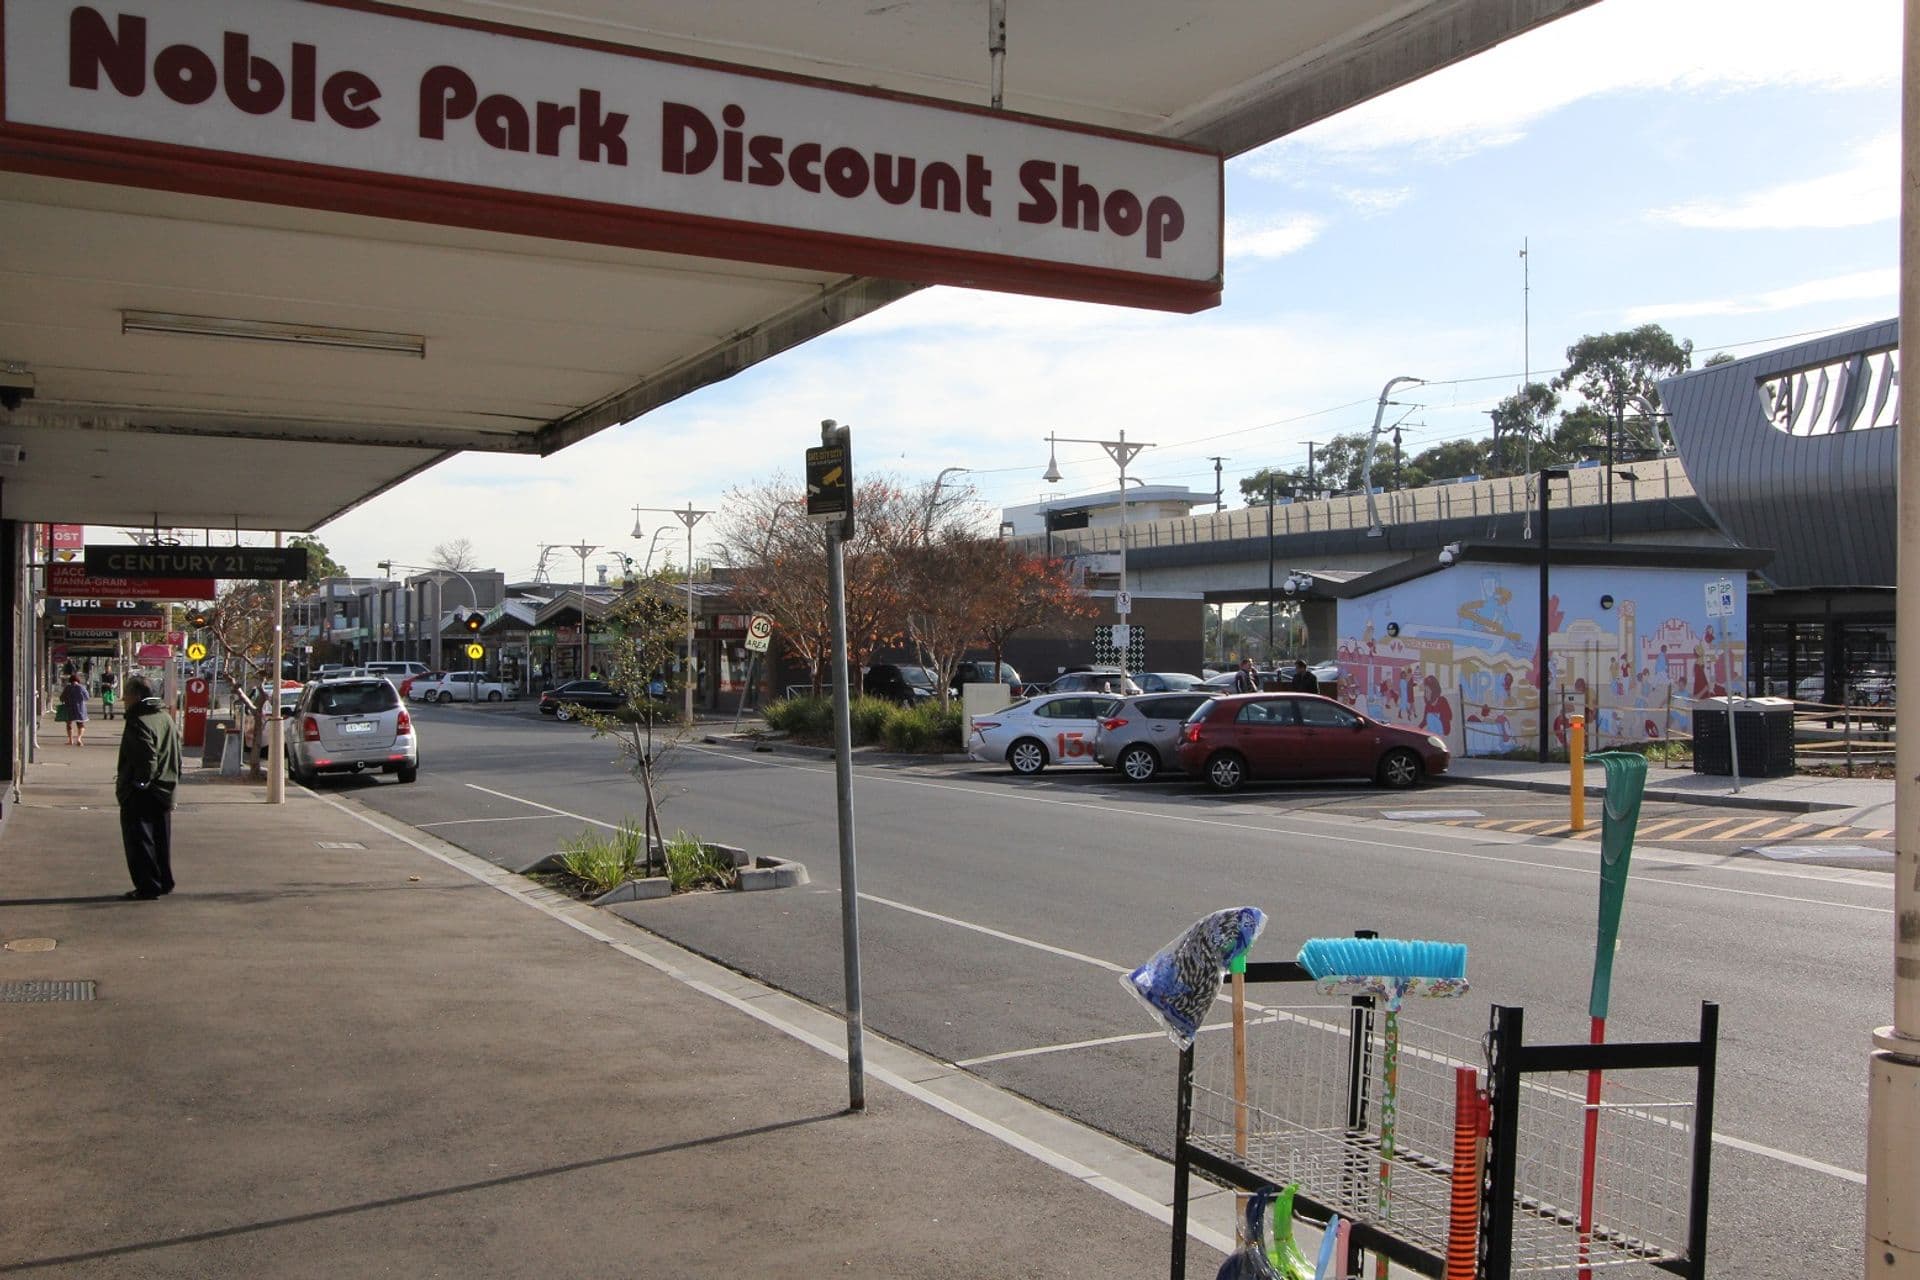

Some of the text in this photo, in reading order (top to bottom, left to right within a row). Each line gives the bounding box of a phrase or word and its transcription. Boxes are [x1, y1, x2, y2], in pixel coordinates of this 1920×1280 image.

[69, 5, 1186, 259] Noble Park Discount Shop
[108, 554, 218, 571] CENTURY
[60, 599, 136, 608] Harcrts
[133, 620, 159, 628] POST
[754, 622, 769, 634] 40
[747, 639, 767, 650] AREA
[188, 706, 207, 714] POST
